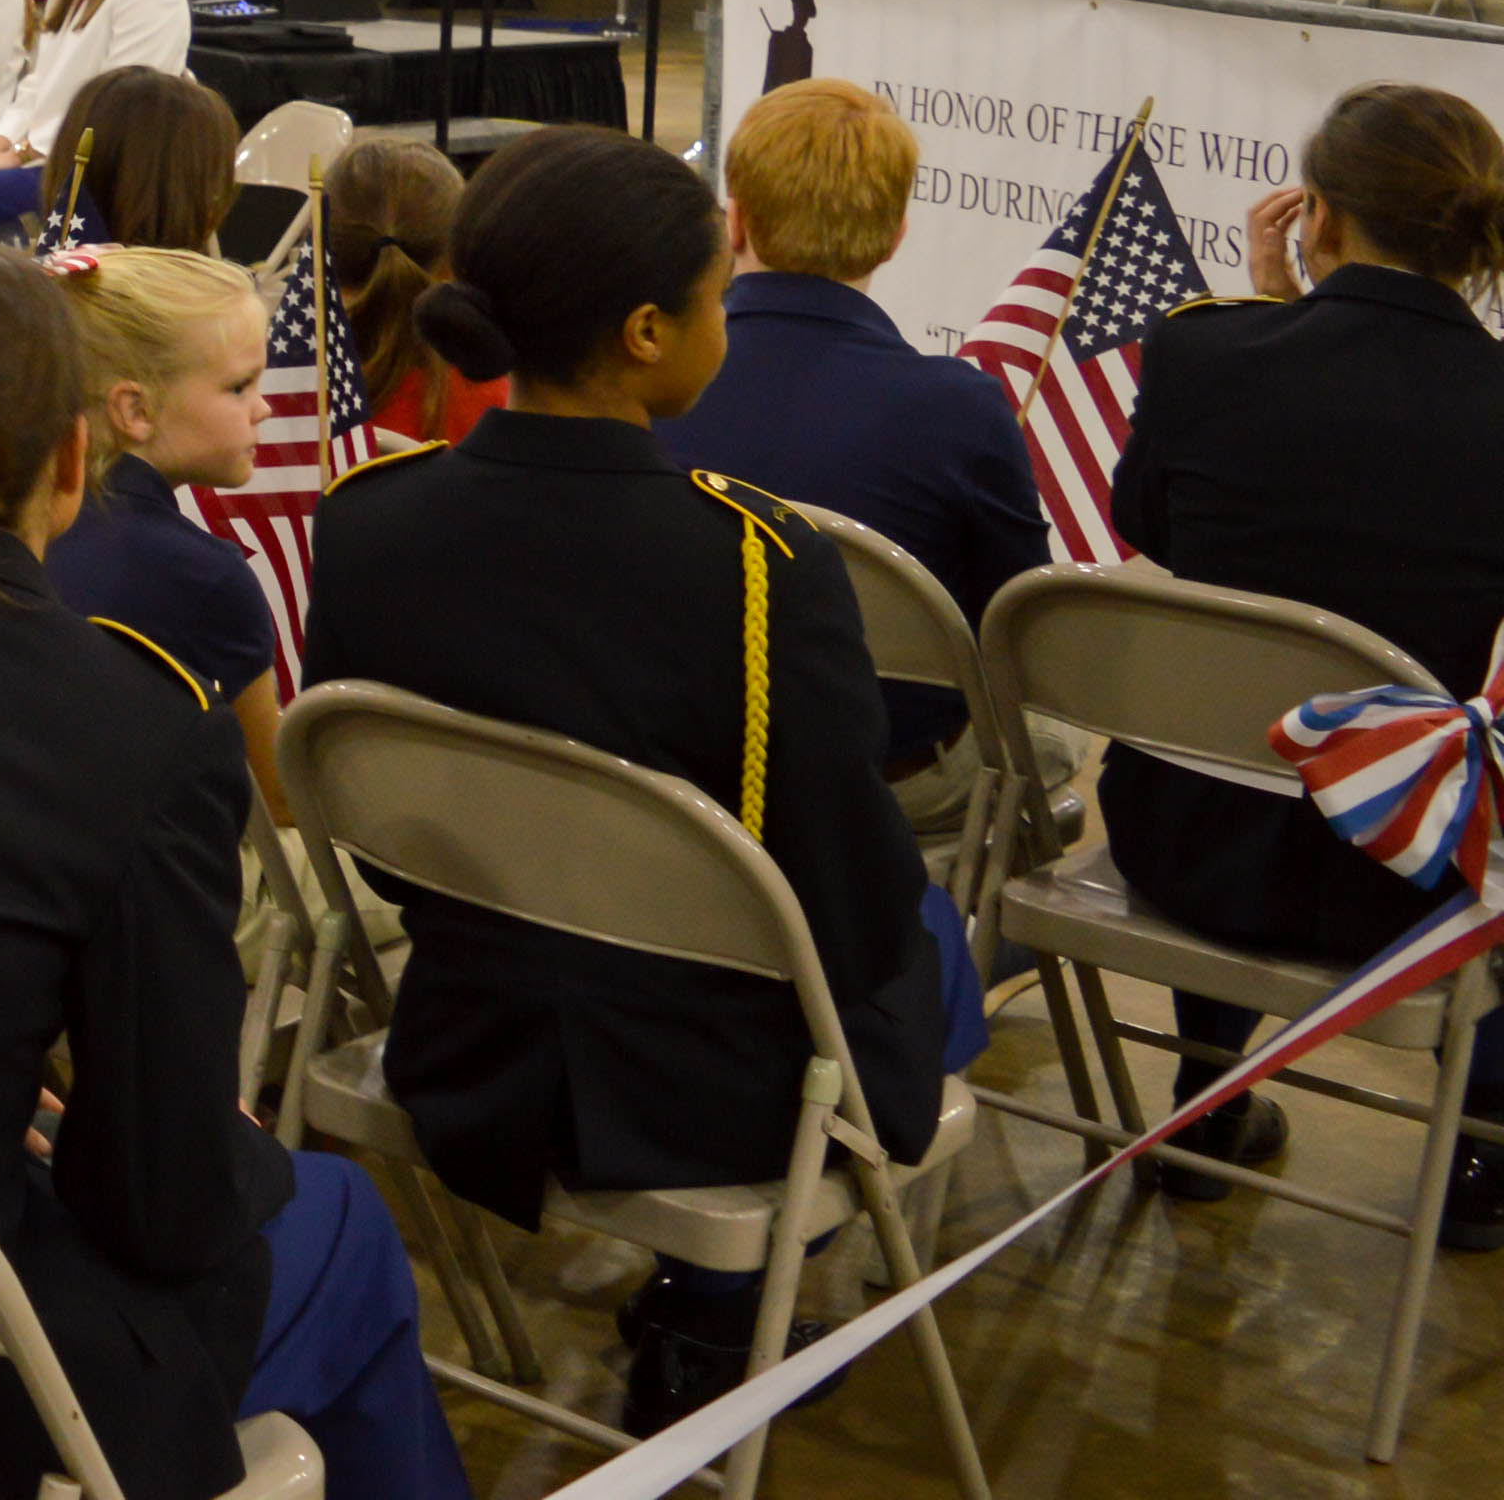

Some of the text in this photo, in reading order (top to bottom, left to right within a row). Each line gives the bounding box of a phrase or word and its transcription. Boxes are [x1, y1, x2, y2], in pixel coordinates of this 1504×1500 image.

[911, 86, 1016, 139] HONOR
[1027, 103, 1068, 145] OF
[1200, 131, 1289, 186] WHO
[913, 165, 952, 205] ED
[1176, 214, 1242, 268] IRS
